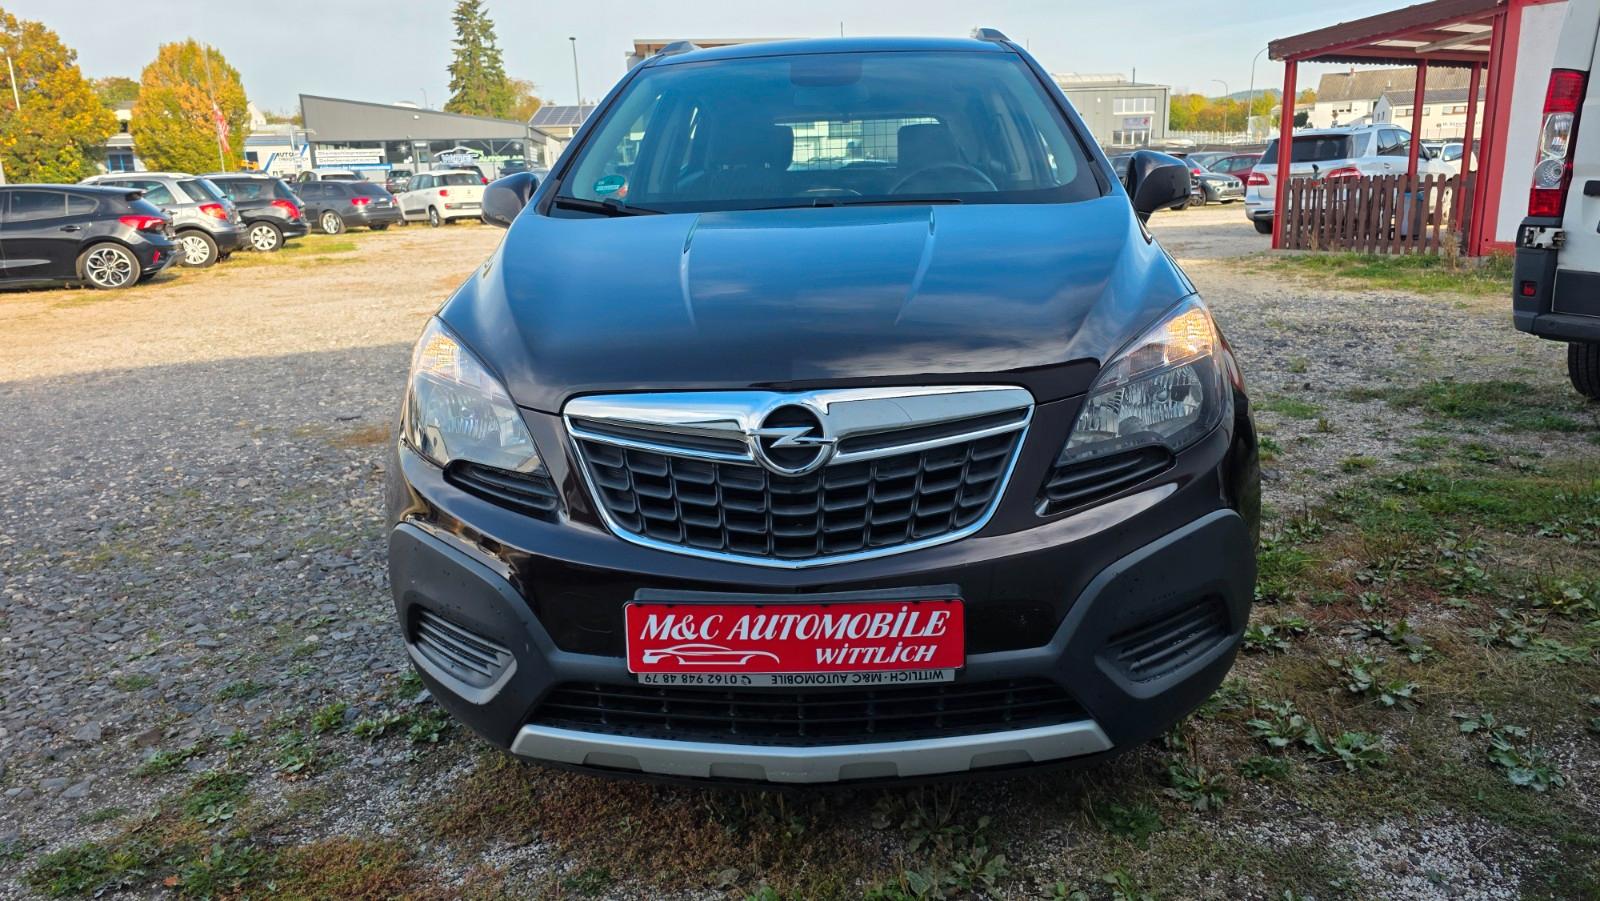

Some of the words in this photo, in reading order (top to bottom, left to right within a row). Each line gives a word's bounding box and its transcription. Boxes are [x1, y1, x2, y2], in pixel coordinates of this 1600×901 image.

[640, 612, 723, 641] M&C
[645, 673, 658, 683] 79
[663, 673, 677, 684] 48
[681, 674, 704, 684] 948
[708, 674, 738, 685] 0162
[771, 673, 848, 685] AUTOMOBILE
[852, 672, 882, 683] M&C
[890, 669, 944, 682] WITTLICH
